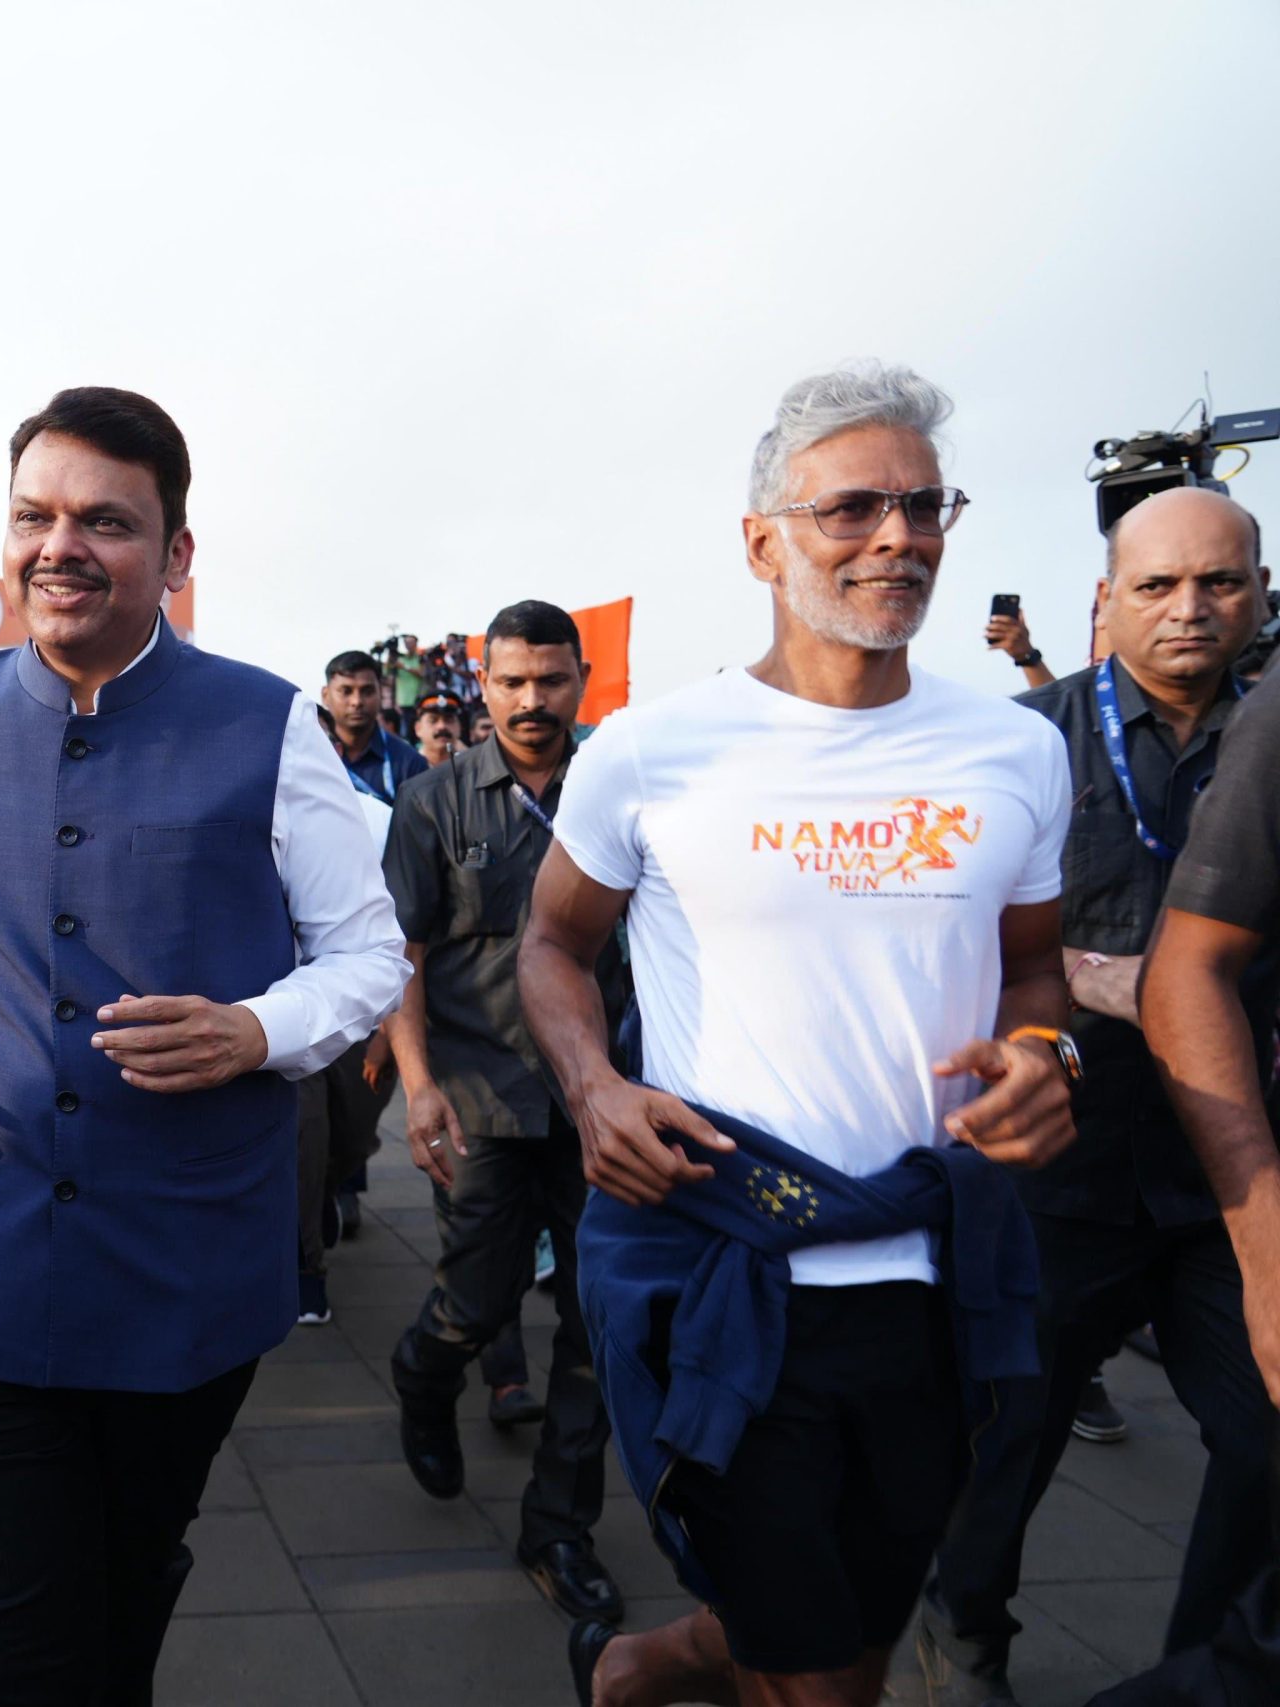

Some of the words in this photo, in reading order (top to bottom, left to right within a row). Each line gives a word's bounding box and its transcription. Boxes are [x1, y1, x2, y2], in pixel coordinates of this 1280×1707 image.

[752, 821, 894, 851] NAMO
[793, 852, 877, 872] YUVA
[829, 875, 880, 891] RUN
